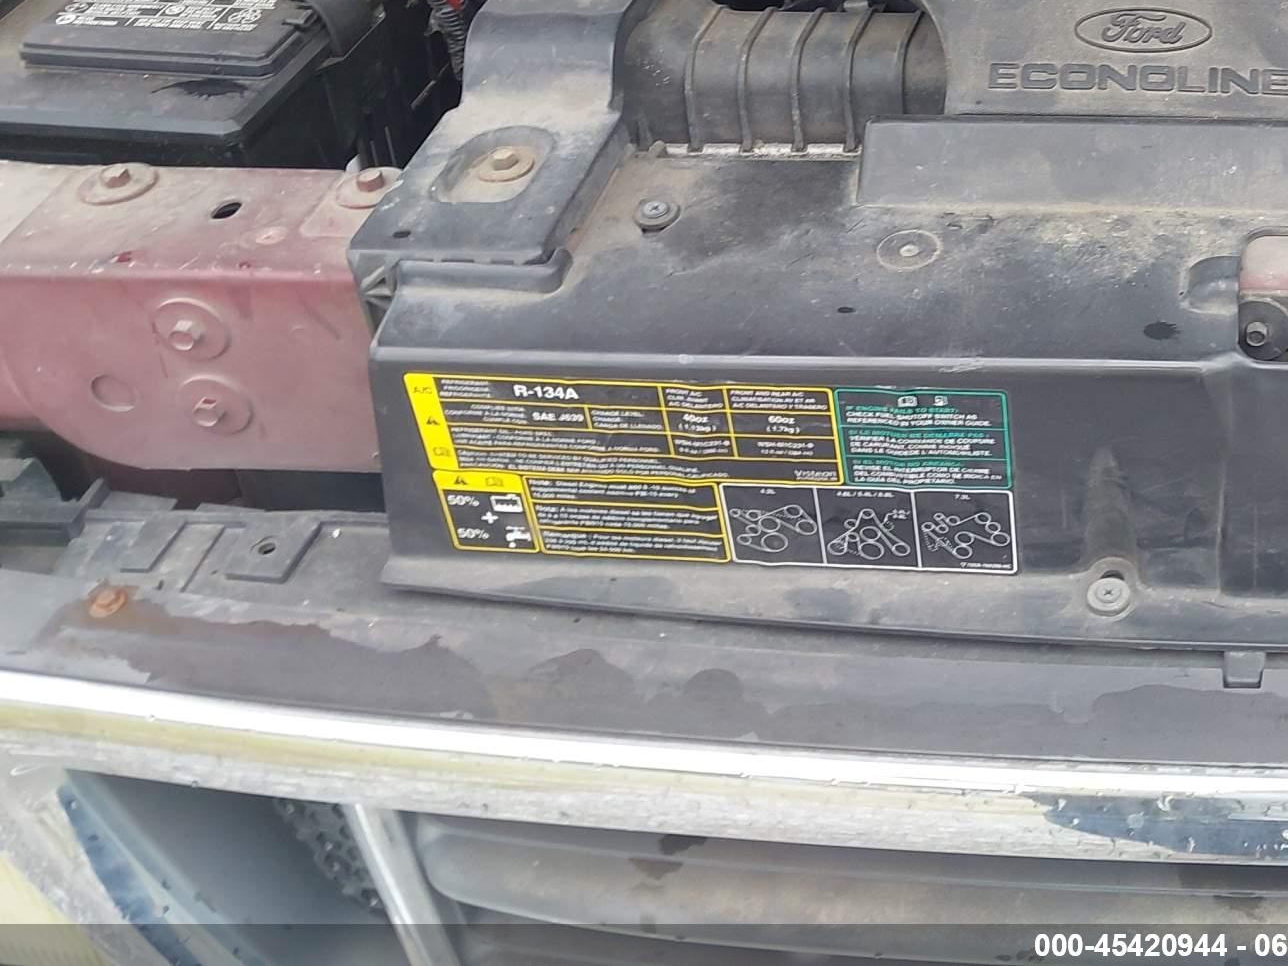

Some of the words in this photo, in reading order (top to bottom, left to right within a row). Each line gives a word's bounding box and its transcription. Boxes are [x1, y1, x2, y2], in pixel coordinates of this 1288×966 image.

[1102, 13, 1186, 44] Ford
[513, 384, 579, 400] R-134A
[532, 412, 556, 421] SAE
[447, 495, 479, 507] 50%
[457, 528, 489, 539] 50%
